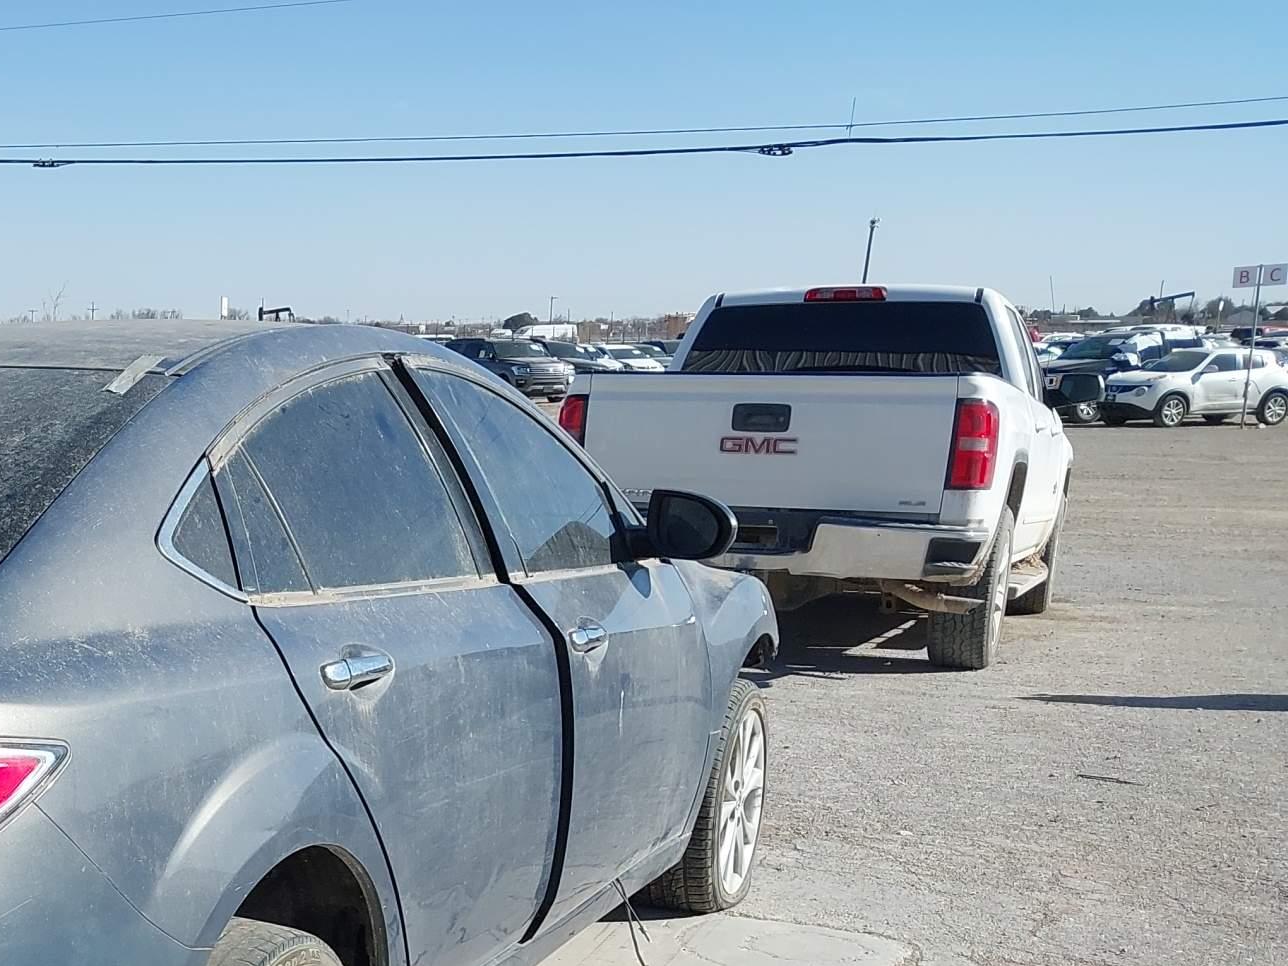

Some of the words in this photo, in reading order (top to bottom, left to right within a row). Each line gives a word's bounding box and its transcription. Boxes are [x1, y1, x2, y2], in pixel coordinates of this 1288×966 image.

[1239, 270, 1249, 283] B
[1270, 267, 1281, 281] C
[720, 437, 797, 454] GMC
